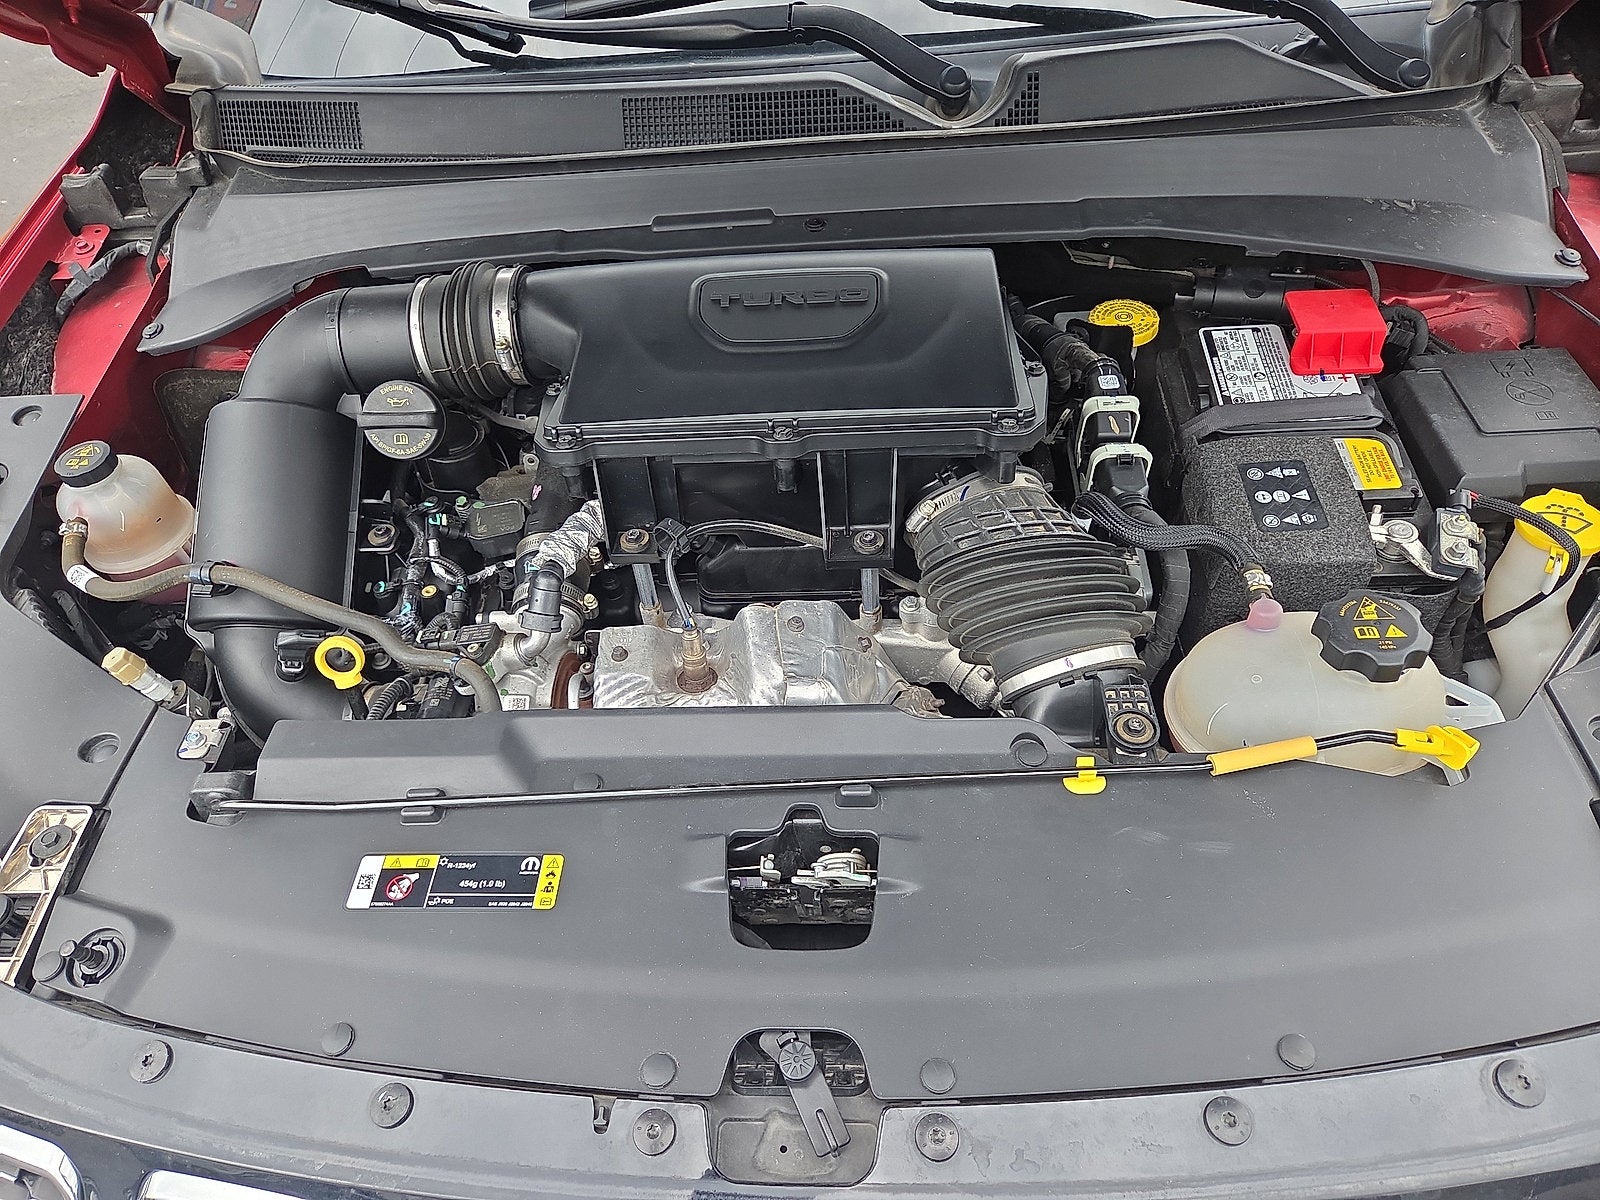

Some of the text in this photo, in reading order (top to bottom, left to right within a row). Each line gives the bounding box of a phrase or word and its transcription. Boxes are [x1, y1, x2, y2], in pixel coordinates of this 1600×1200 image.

[710, 287, 869, 308] TURBO
[379, 384, 414, 395] ENGINE OIL
[447, 862, 477, 870] R-1234yf
[459, 879, 506, 889] 454g (1.0 lb)
